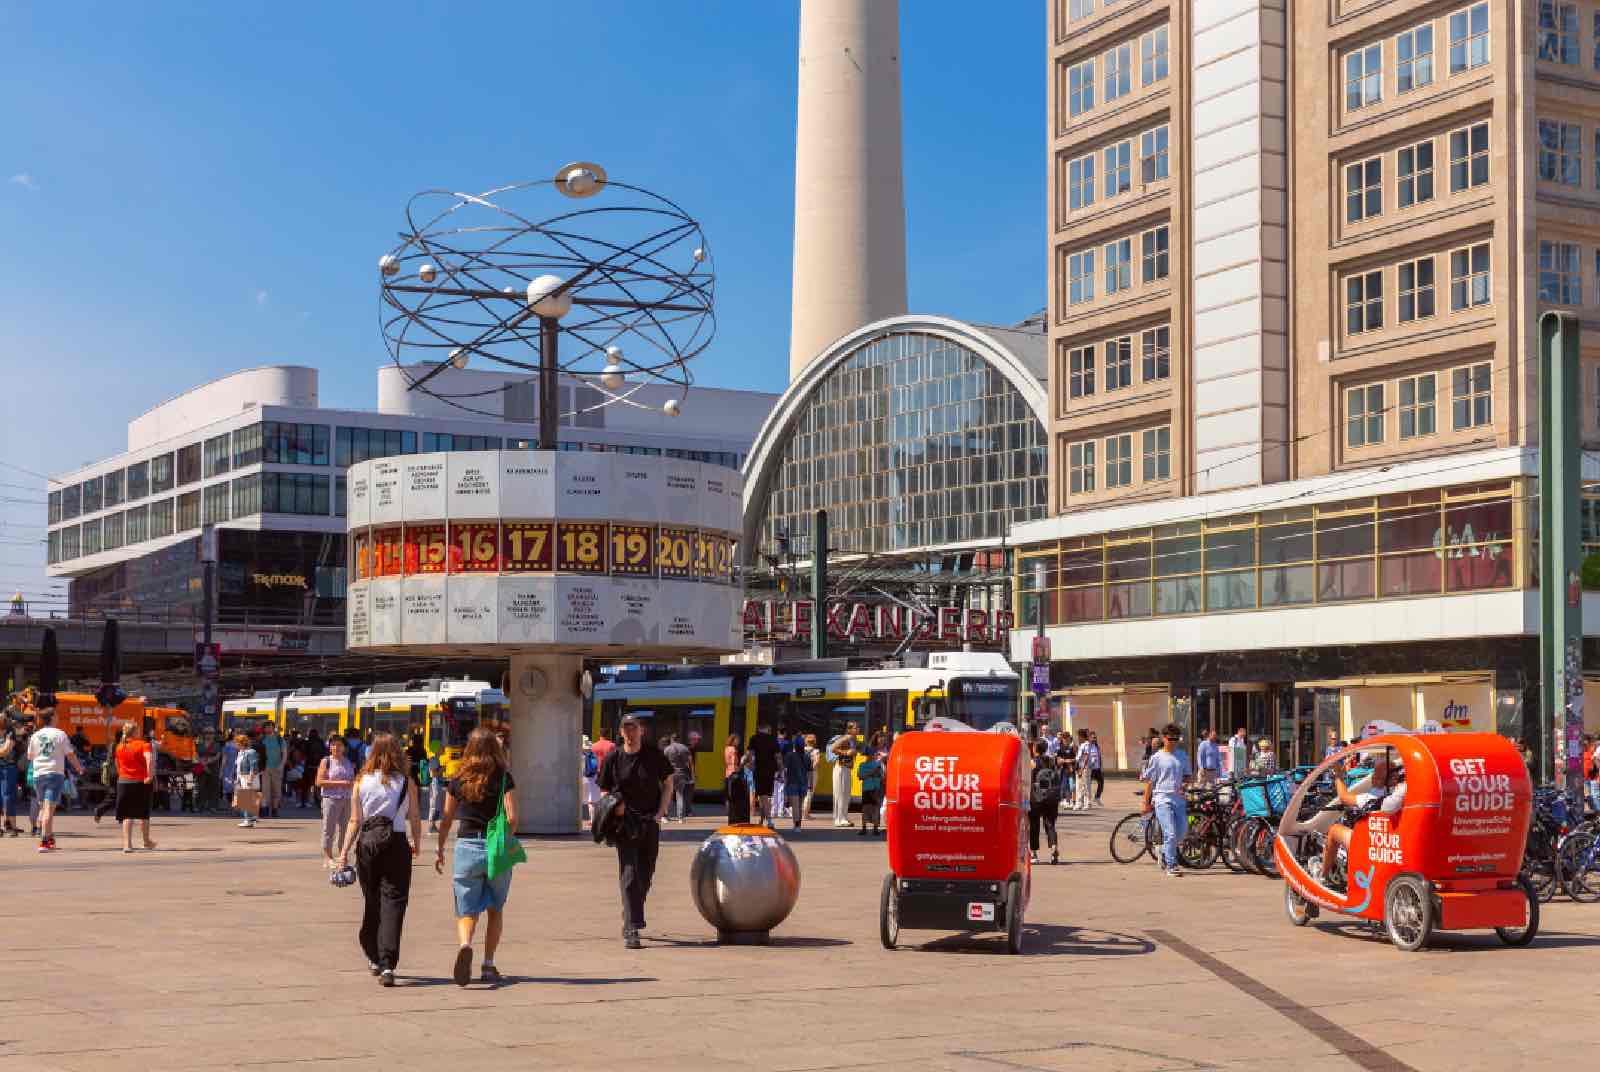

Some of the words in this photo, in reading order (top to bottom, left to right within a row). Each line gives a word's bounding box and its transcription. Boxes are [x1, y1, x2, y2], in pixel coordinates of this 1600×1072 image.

[417, 532, 446, 563] 15
[458, 530, 495, 562] 16
[508, 529, 549, 562] 17
[562, 531, 599, 563] 18
[612, 532, 648, 564] 19
[655, 535, 690, 568] 20
[1443, 699, 1468, 720] dm
[914, 756, 960, 773] GET
[1450, 758, 1486, 775] GET
[915, 773, 980, 791] YOUR
[1455, 775, 1511, 793] YOUR
[914, 792, 984, 811] GUIDE
[1456, 793, 1515, 812] GUIDE
[1368, 816, 1390, 832] GET
[1368, 832, 1400, 848] YOUR
[1368, 847, 1403, 865] GUIDE
